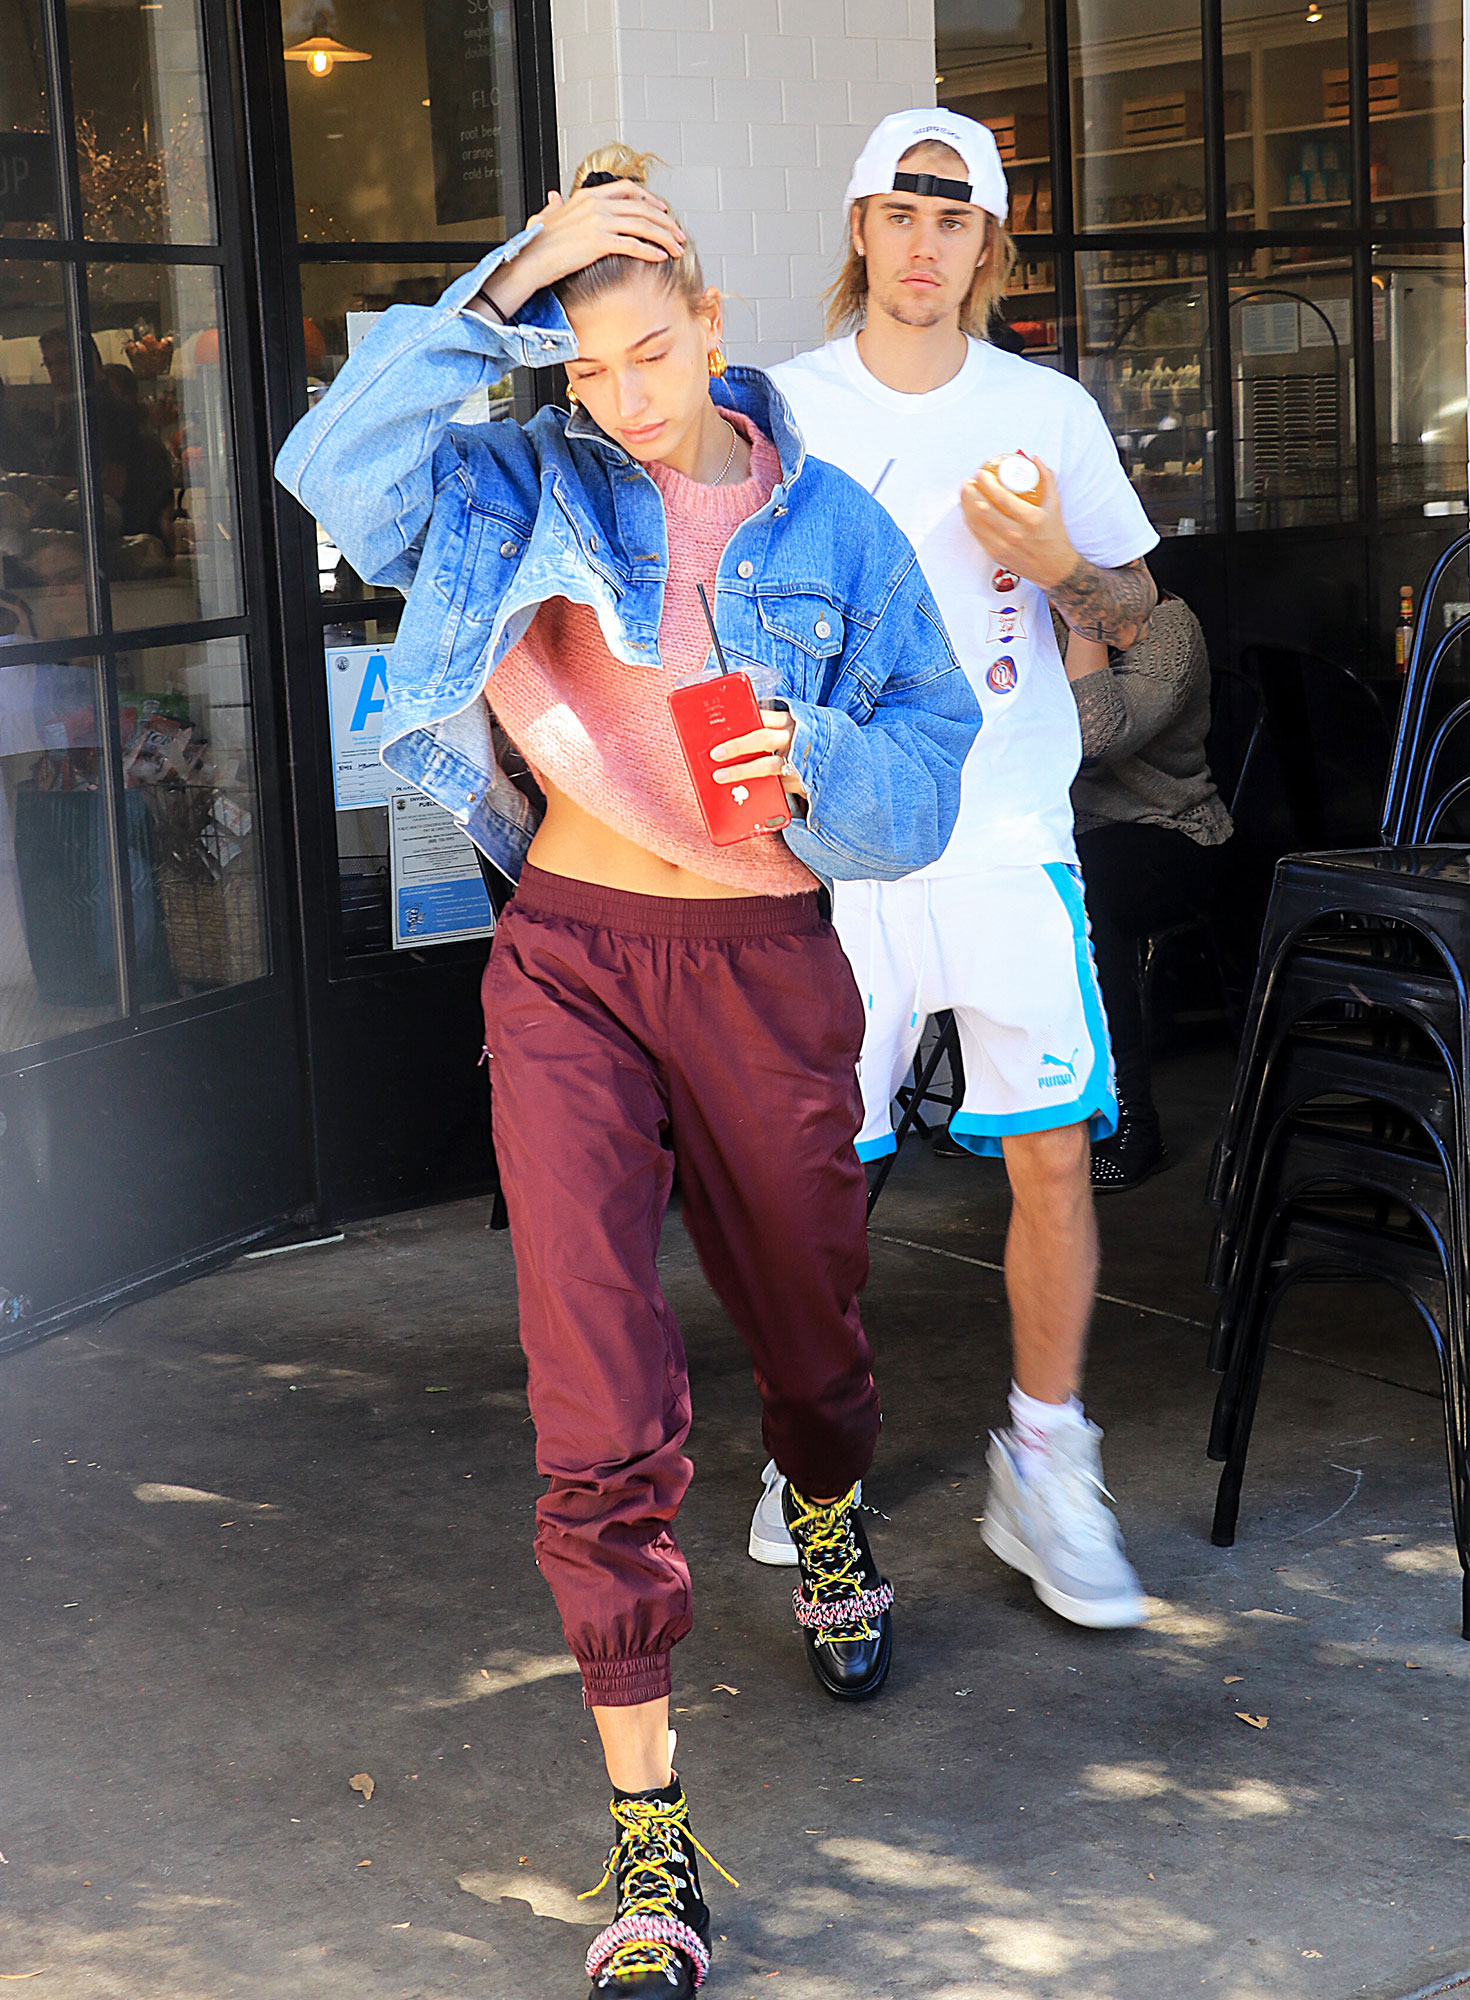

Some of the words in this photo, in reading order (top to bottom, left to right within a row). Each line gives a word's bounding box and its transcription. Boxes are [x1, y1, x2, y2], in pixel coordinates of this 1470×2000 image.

[460, 126, 479, 142] root
[462, 148, 494, 162] orange
[463, 168, 482, 181] cold
[350, 655, 389, 732] A
[1038, 1073, 1072, 1089] PUMA
